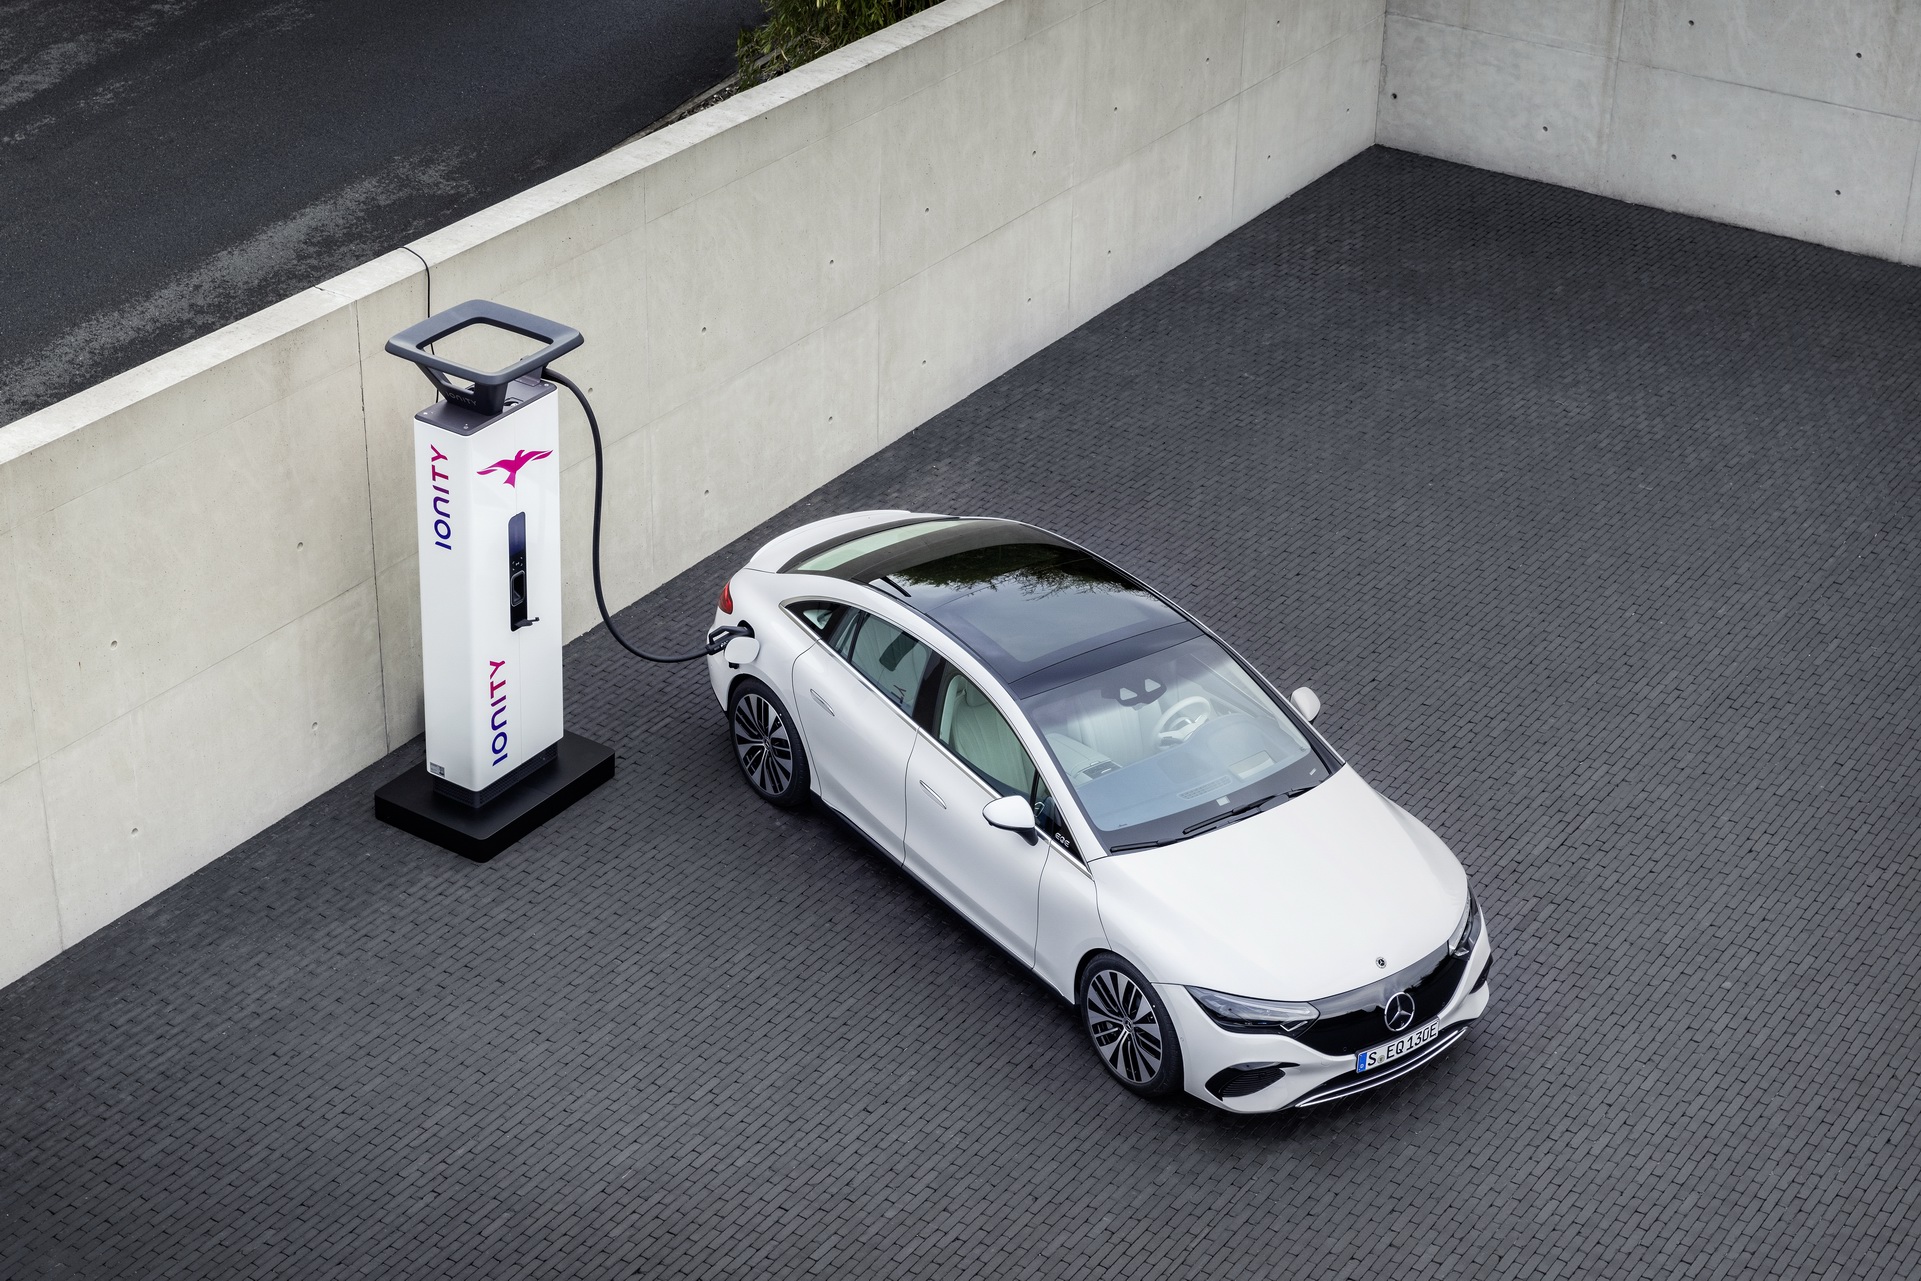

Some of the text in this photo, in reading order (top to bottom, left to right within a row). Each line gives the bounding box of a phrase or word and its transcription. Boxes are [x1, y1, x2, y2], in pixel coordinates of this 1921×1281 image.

[445, 391, 477, 406] IONITY
[430, 444, 452, 550] IONITY
[489, 660, 508, 767] IONITY
[1055, 832, 1070, 848] EQE
[1367, 1051, 1377, 1066] S
